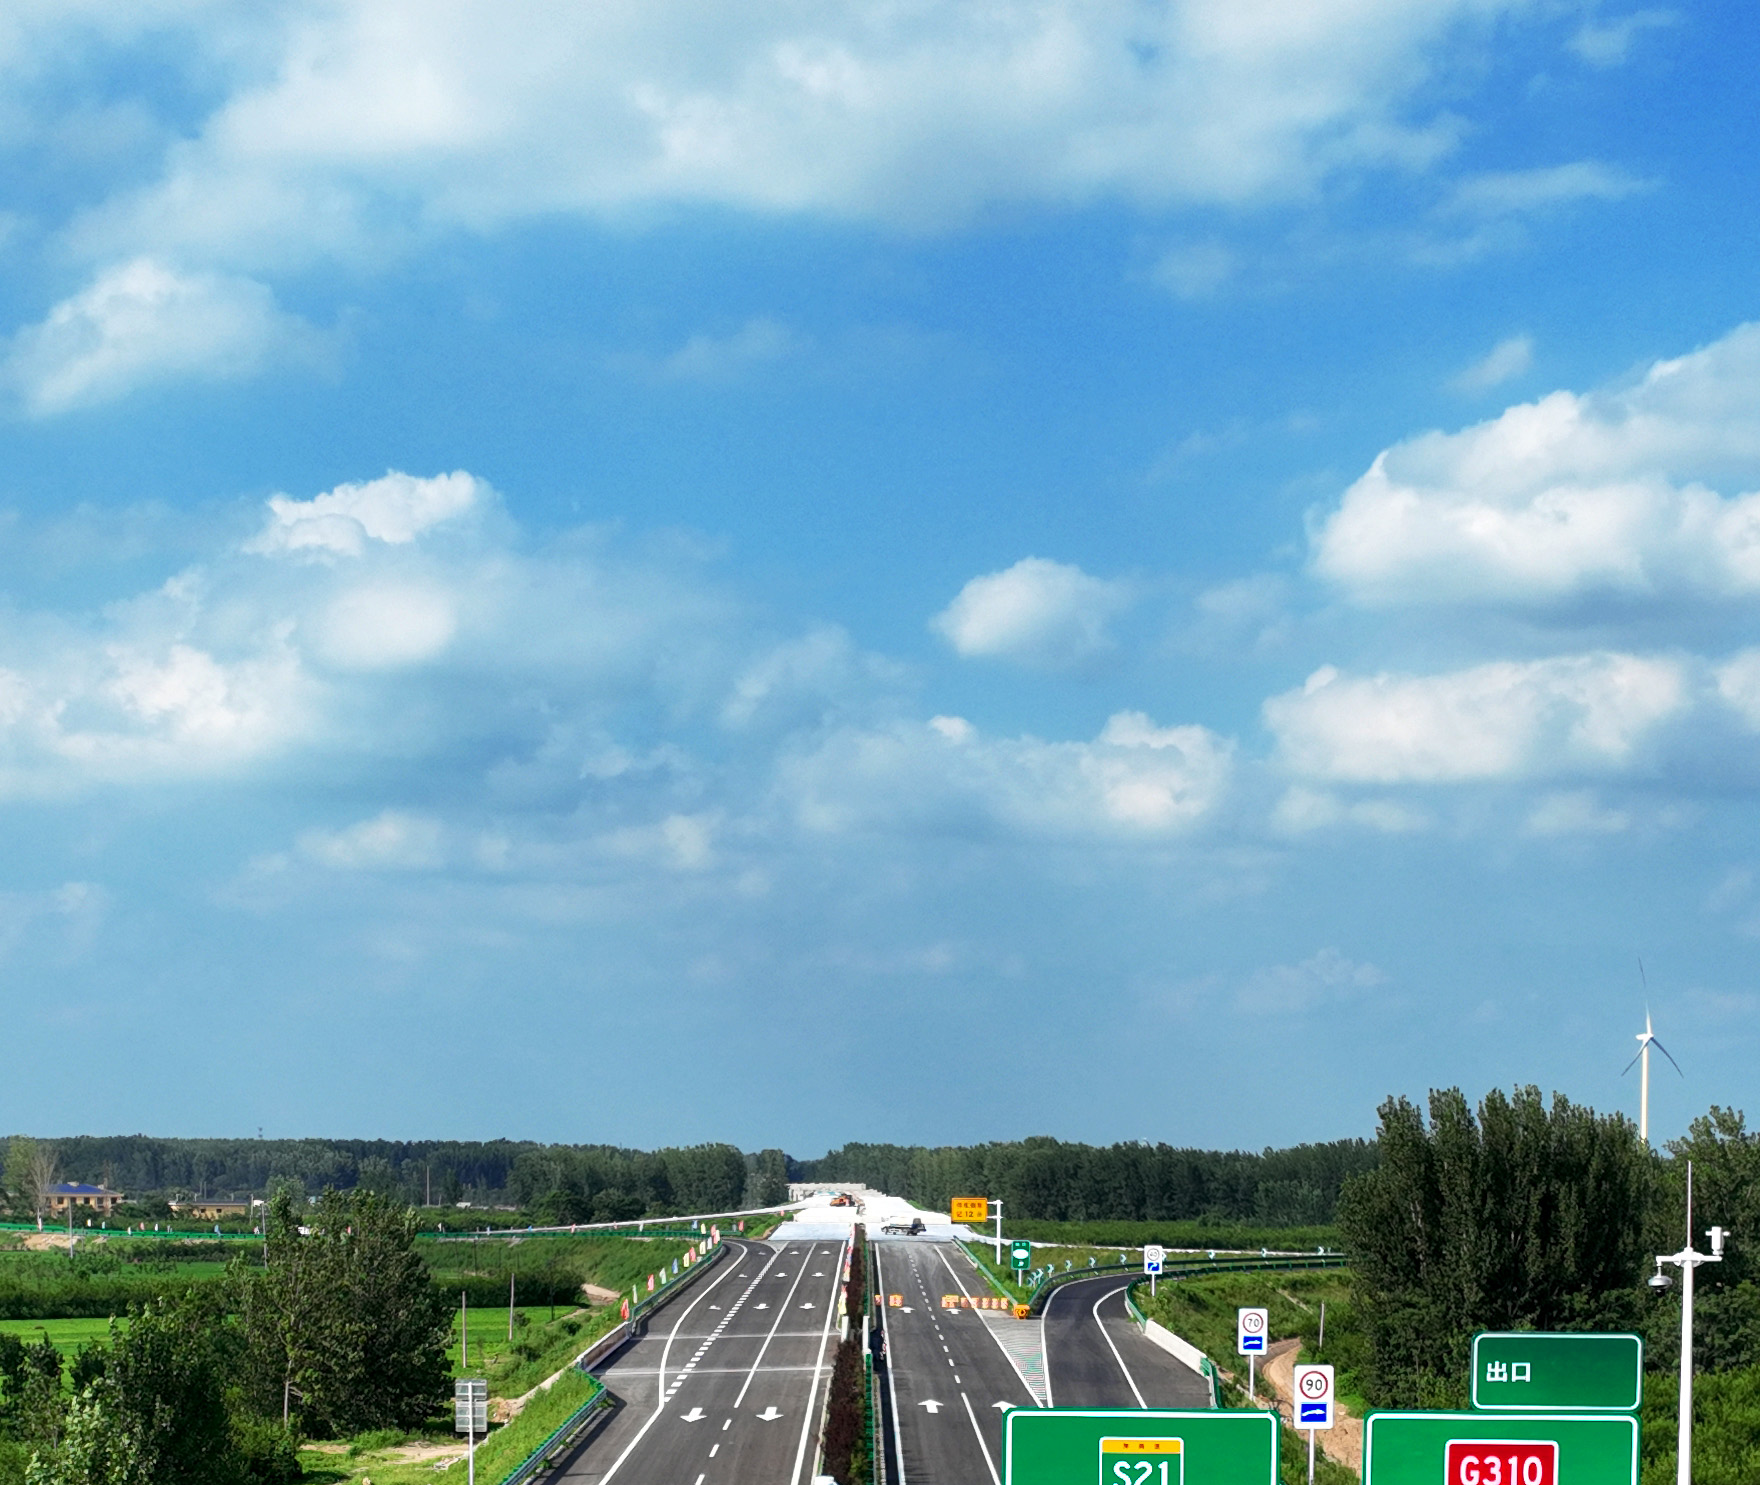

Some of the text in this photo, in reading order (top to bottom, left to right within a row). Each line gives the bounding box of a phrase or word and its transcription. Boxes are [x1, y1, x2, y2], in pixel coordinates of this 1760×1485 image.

[1248, 1319, 1260, 1328] 70
[1486, 1361, 1532, 1383] 出口
[1306, 1379, 1323, 1391] 90
